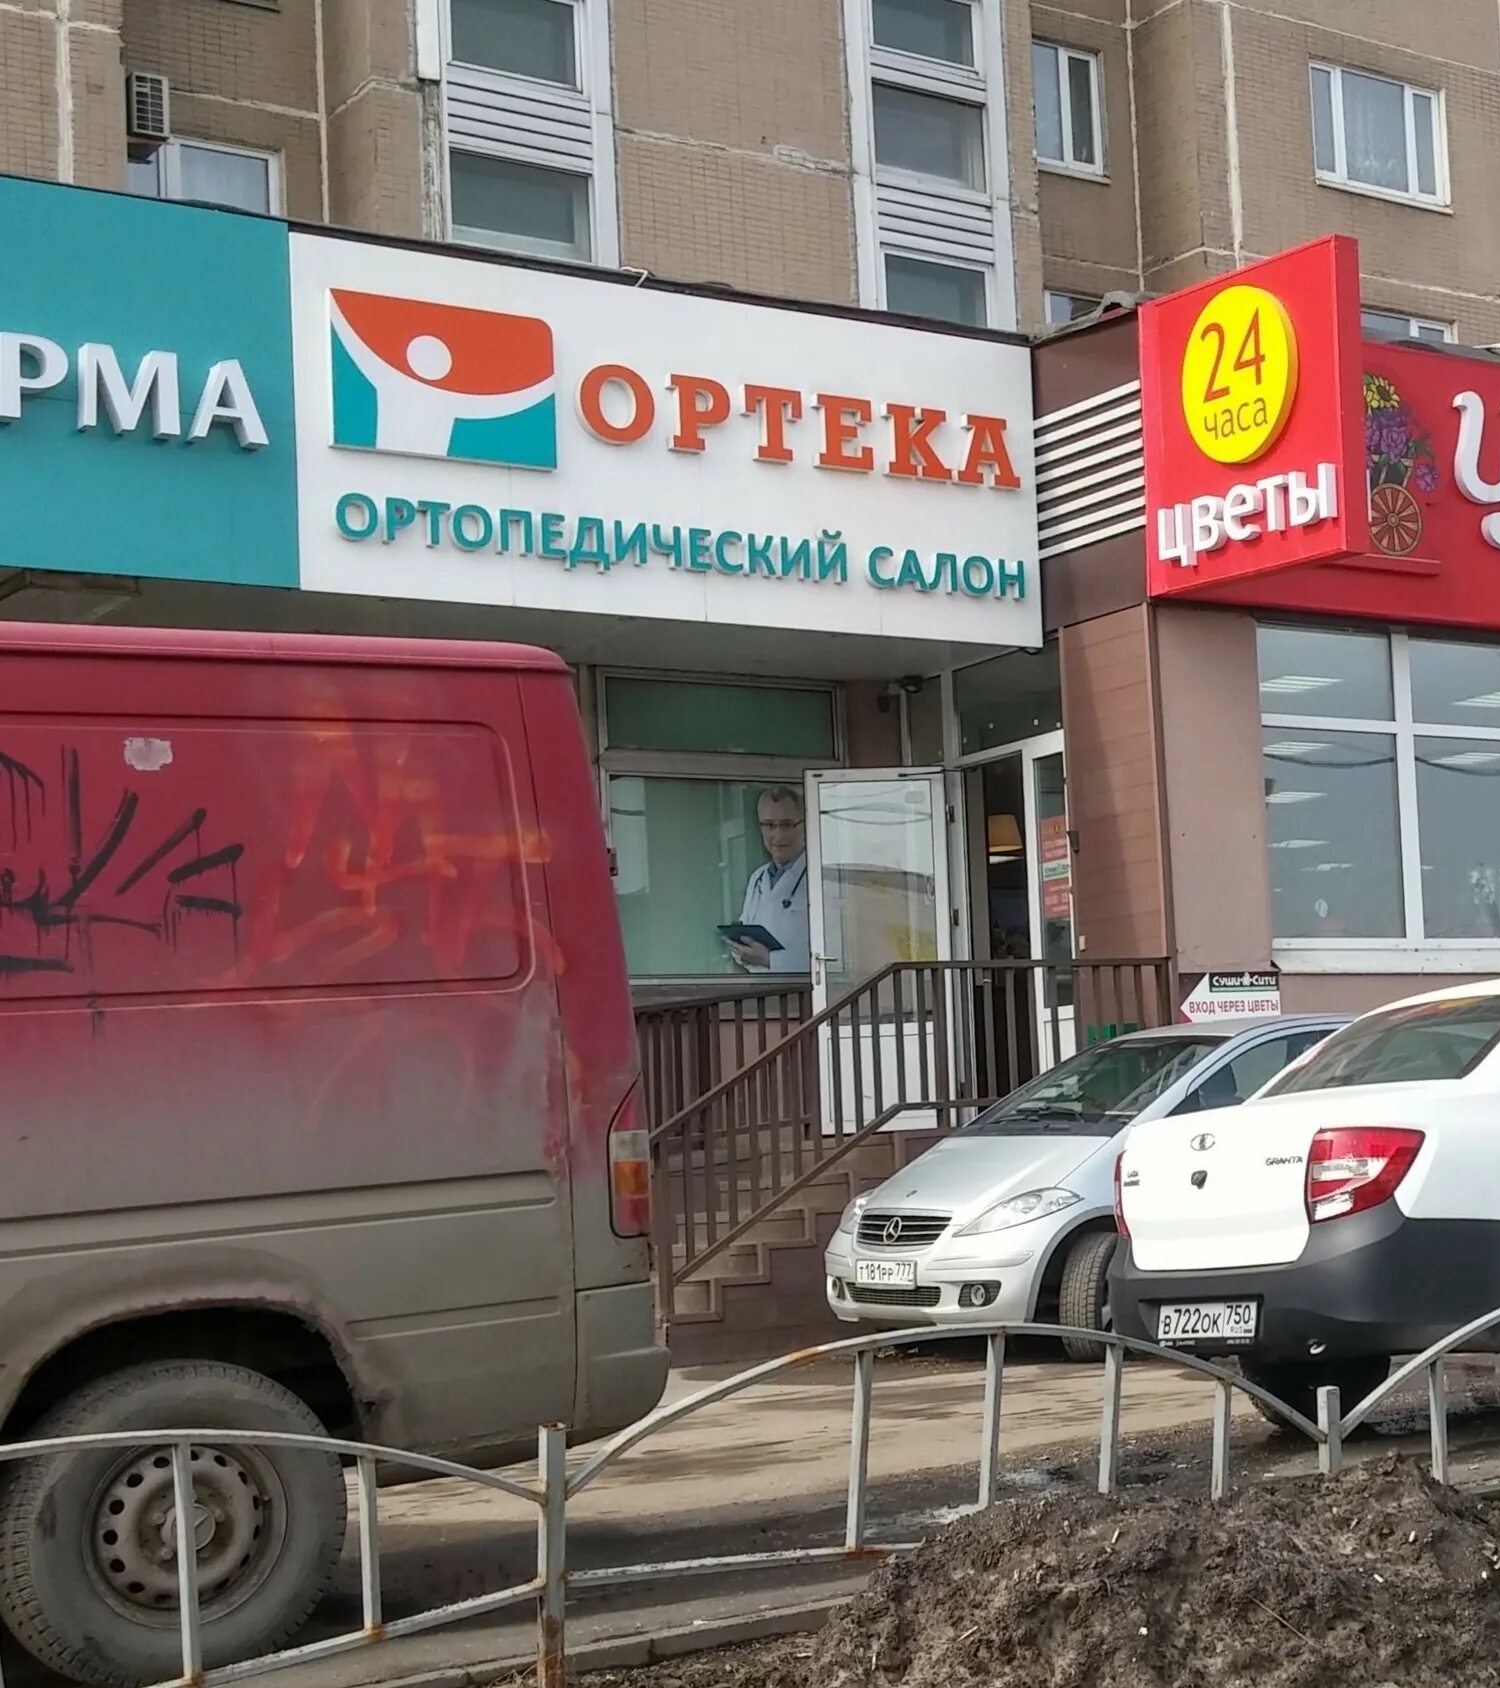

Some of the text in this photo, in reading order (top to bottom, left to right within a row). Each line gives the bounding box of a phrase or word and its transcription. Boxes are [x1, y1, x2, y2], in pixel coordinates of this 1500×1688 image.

[1199, 307, 1267, 403] 24
[575, 363, 1021, 491] ОРТЕКА
[1203, 395, 1268, 441] часа
[1157, 462, 1337, 567] цветы
[335, 492, 1026, 600] ОРТОПЕДИЧЕСКИЙ САЛОН
[1212, 974, 1276, 986] Суши Сити
[1189, 999, 1279, 1014] ВХОД ЧЕРЕЗ ЦВЕТЫ
[896, 1263, 911, 1276] 777
[1226, 1304, 1251, 1326] 750
